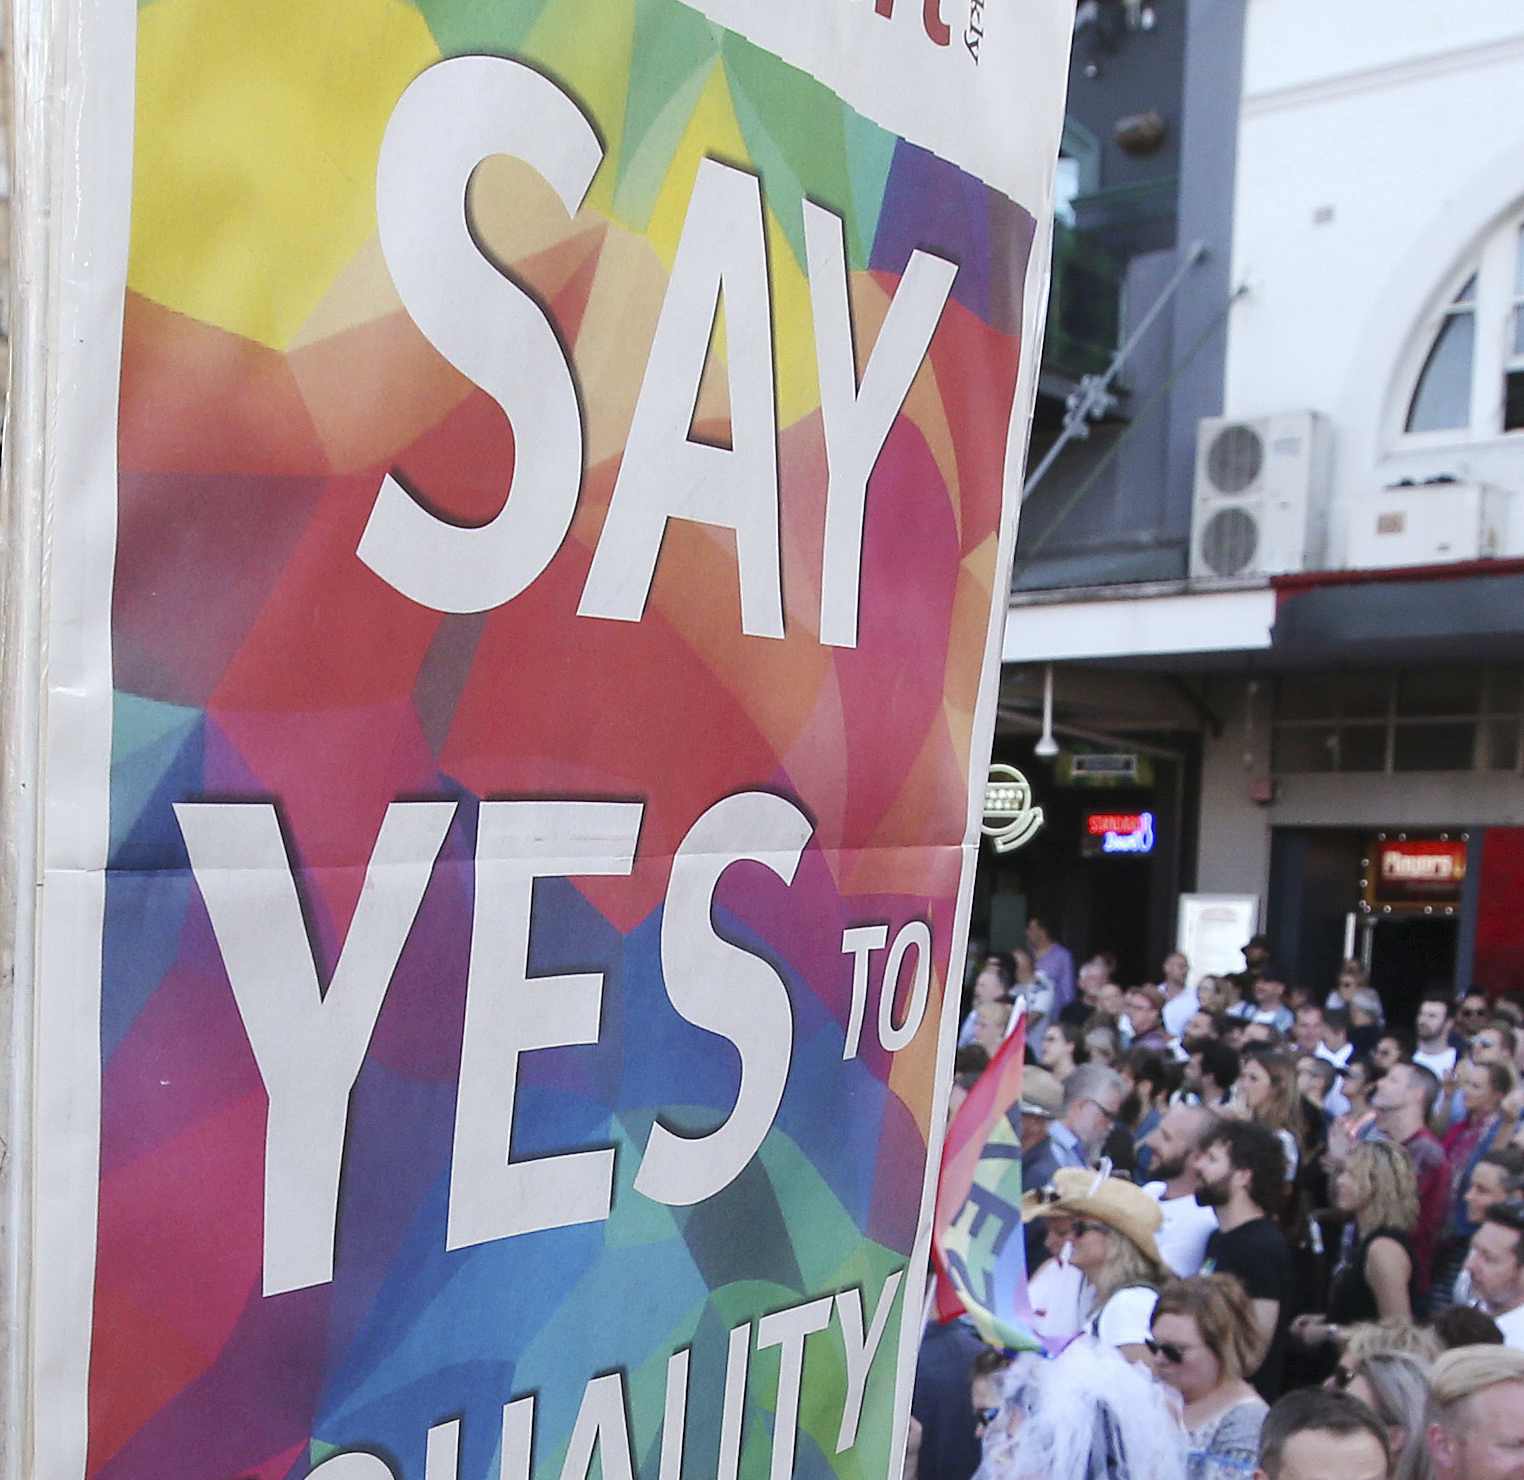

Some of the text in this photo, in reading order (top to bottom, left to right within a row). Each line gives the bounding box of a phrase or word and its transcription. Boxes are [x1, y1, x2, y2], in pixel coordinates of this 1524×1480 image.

[355, 54, 959, 648] SAY
[172, 790, 932, 1298] YES TO
